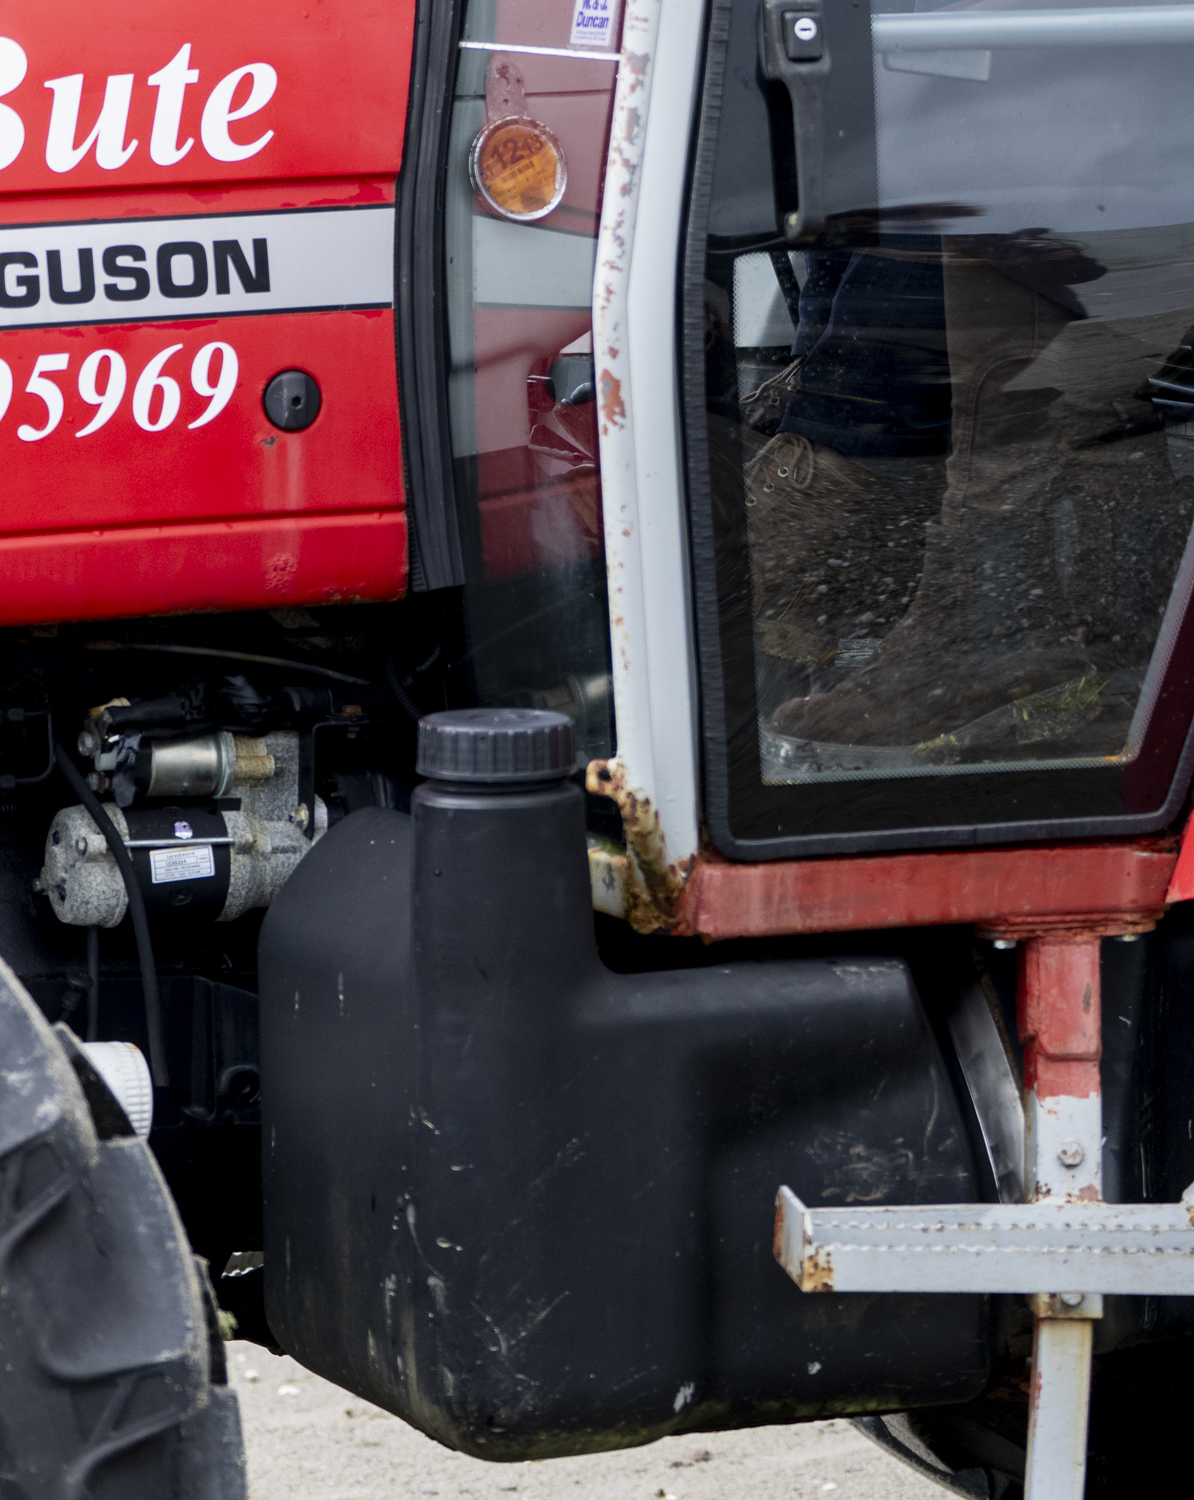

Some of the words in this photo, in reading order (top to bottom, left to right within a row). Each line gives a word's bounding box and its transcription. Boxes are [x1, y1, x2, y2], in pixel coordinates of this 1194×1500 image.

[575, 11, 610, 29] Duncan
[0, 36, 277, 172] ute
[0, 342, 238, 441] 5969
